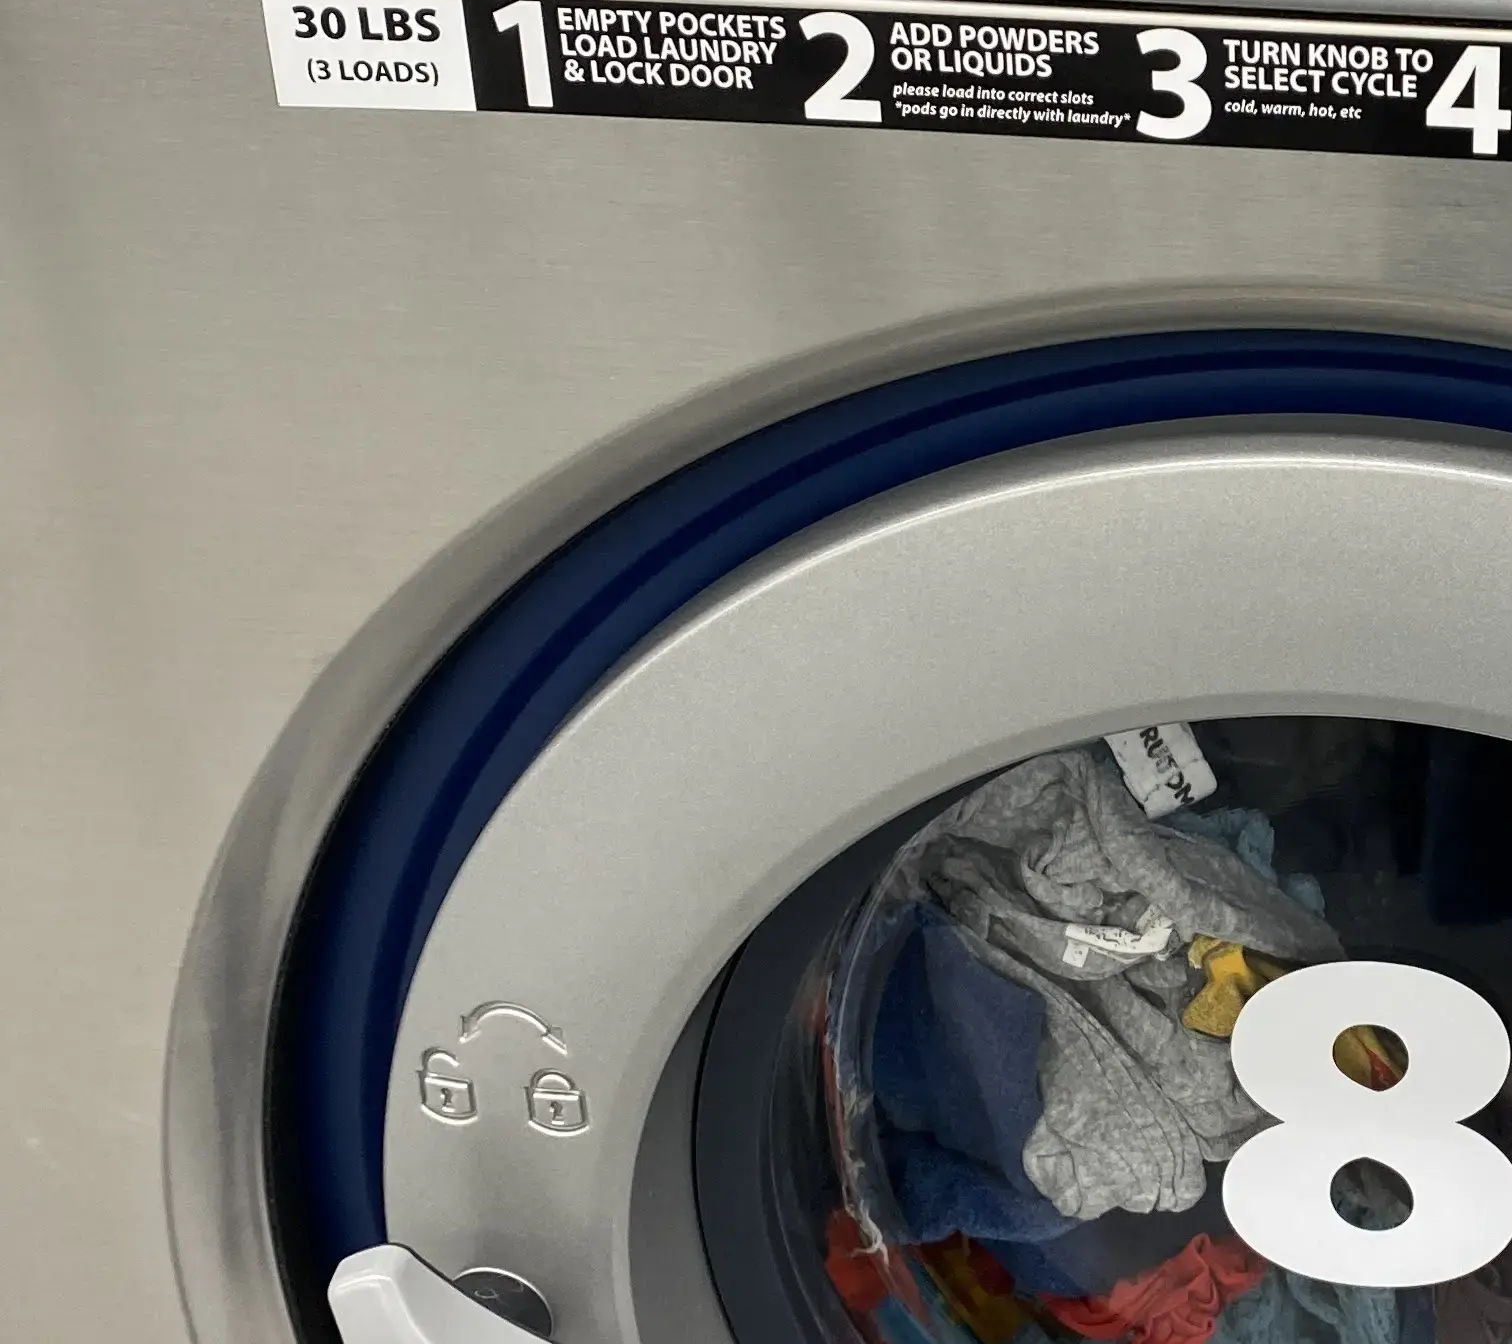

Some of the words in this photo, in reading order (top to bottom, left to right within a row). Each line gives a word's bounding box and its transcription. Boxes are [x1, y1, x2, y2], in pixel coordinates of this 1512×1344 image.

[292, 7, 347, 41] 30
[357, 7, 441, 43] LBS
[558, 8, 652, 33] EMPTY
[659, 12, 786, 39] POCKETS
[890, 22, 952, 46] ADD
[960, 25, 1099, 54] POWDERS
[493, 0, 553, 108] 1
[560, 34, 637, 58] LOAD
[644, 37, 777, 64] LAUNDRY
[892, 47, 932, 71] OR
[938, 49, 1052, 77] LIQUIDS
[1223, 39, 1300, 66] TURN
[1309, 44, 1388, 70] KNOB
[1395, 48, 1433, 72] TO
[306, 59, 331, 83] (3
[339, 60, 439, 86] LOADS)
[564, 59, 585, 82] &
[591, 60, 664, 85] LOCK
[670, 64, 753, 89] DOOR
[799, 11, 882, 123] 2
[1225, 66, 1325, 93] SELECT
[1332, 71, 1417, 98] CYCLE
[893, 82, 939, 98] please
[942, 84, 974, 98] load
[977, 86, 1005, 100] into
[1008, 91, 1058, 103] correct
[1060, 90, 1093, 105] slots
[1136, 28, 1212, 140] 3
[1425, 45, 1511, 155] 4
[1225, 99, 1258, 114] cold,
[1262, 104, 1305, 117] warm,
[1309, 103, 1336, 119] hot,
[1340, 106, 1362, 119] etc
